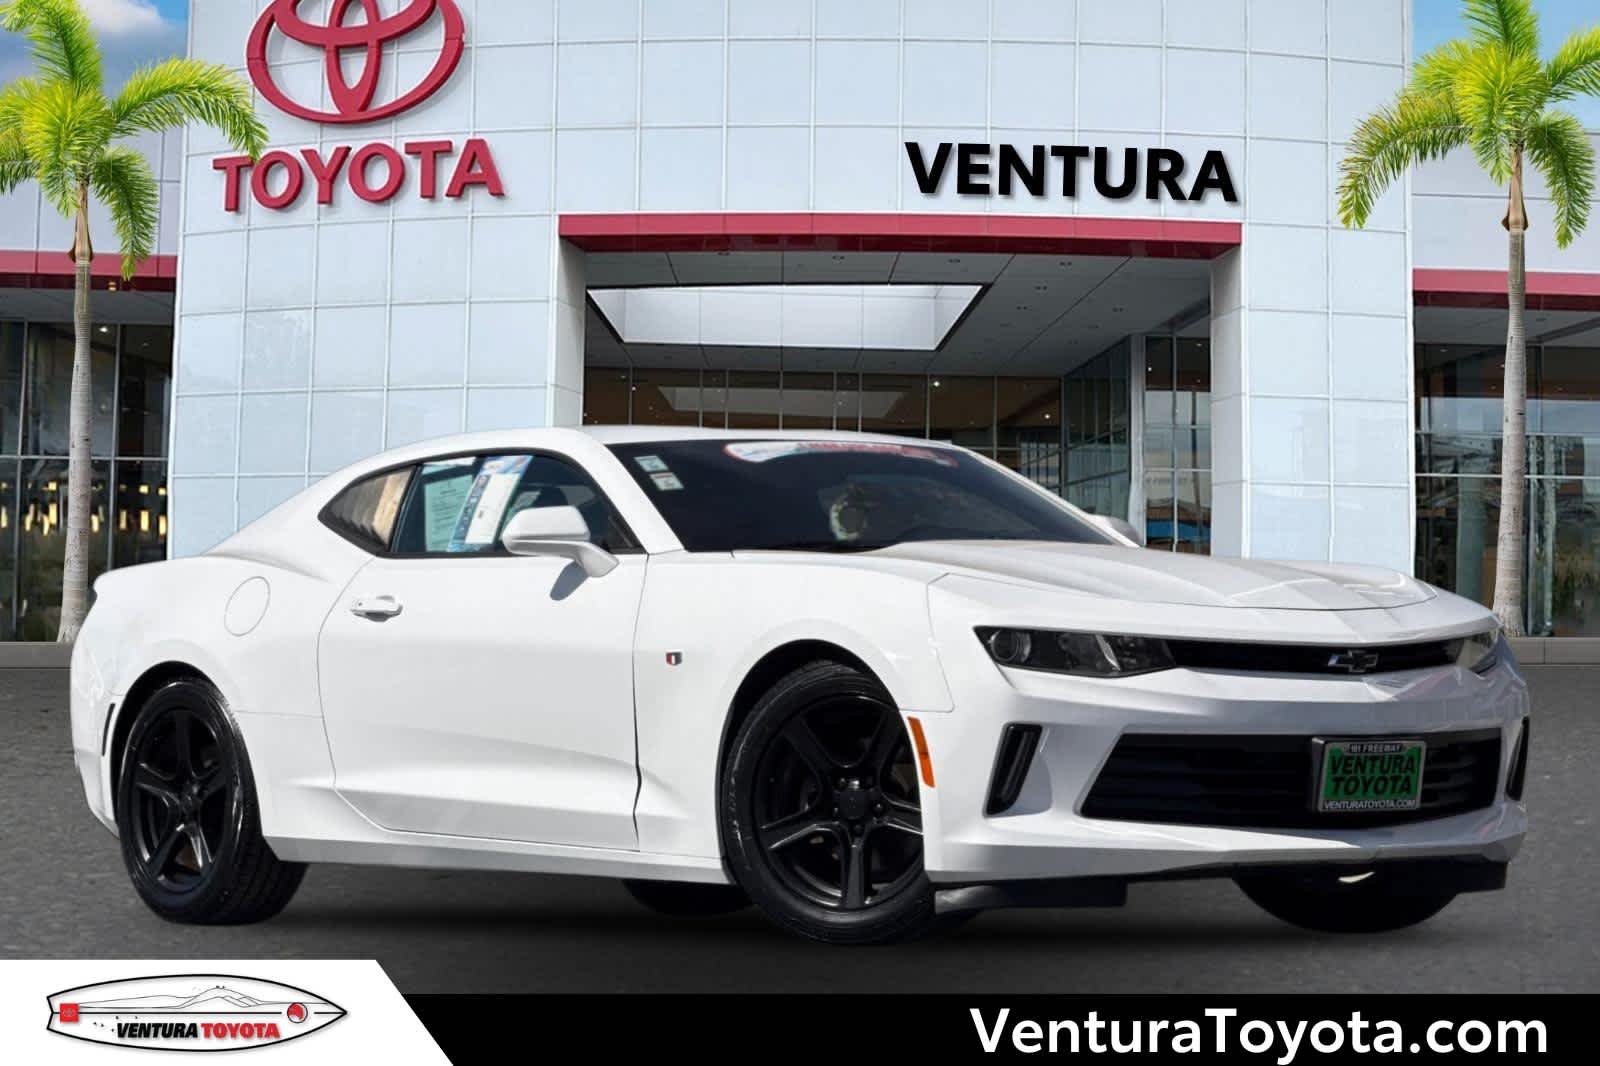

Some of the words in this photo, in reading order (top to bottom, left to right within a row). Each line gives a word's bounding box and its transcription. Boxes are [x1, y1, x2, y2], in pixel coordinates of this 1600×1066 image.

[213, 138, 505, 212] TOYOTA
[904, 142, 1239, 202] VENTURA
[1362, 743, 1401, 753] FREEWAY
[1329, 754, 1416, 775] VENTURA
[1332, 775, 1412, 796] TOYOTA
[1324, 799, 1416, 810] VENTURATOYOTA.COM
